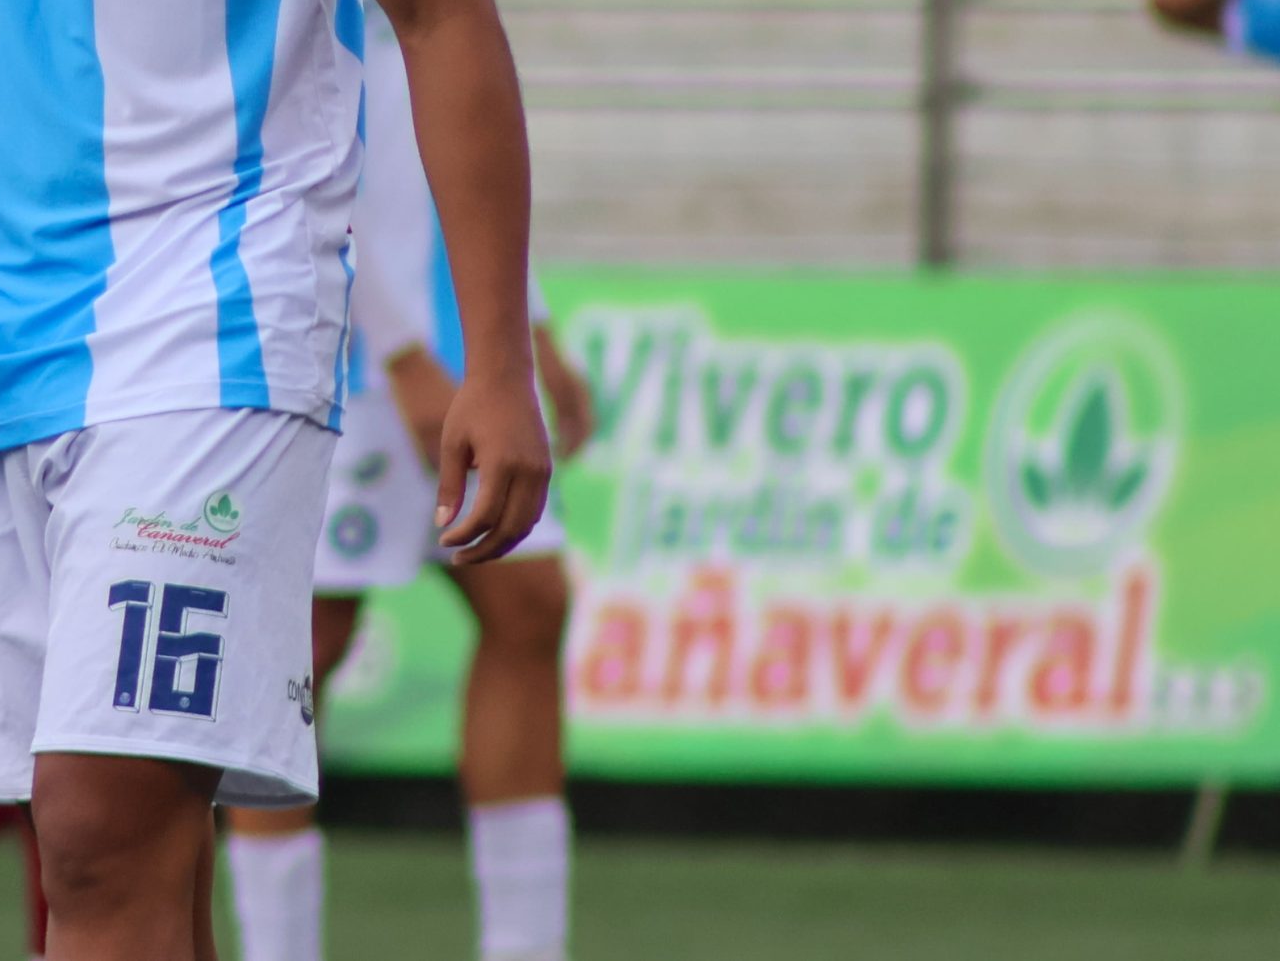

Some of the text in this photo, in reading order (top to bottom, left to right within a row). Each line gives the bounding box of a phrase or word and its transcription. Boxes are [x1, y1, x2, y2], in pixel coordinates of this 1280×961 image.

[586, 325, 951, 459] Vivero
[108, 580, 230, 723] 16
[576, 569, 1149, 717] añaveral
